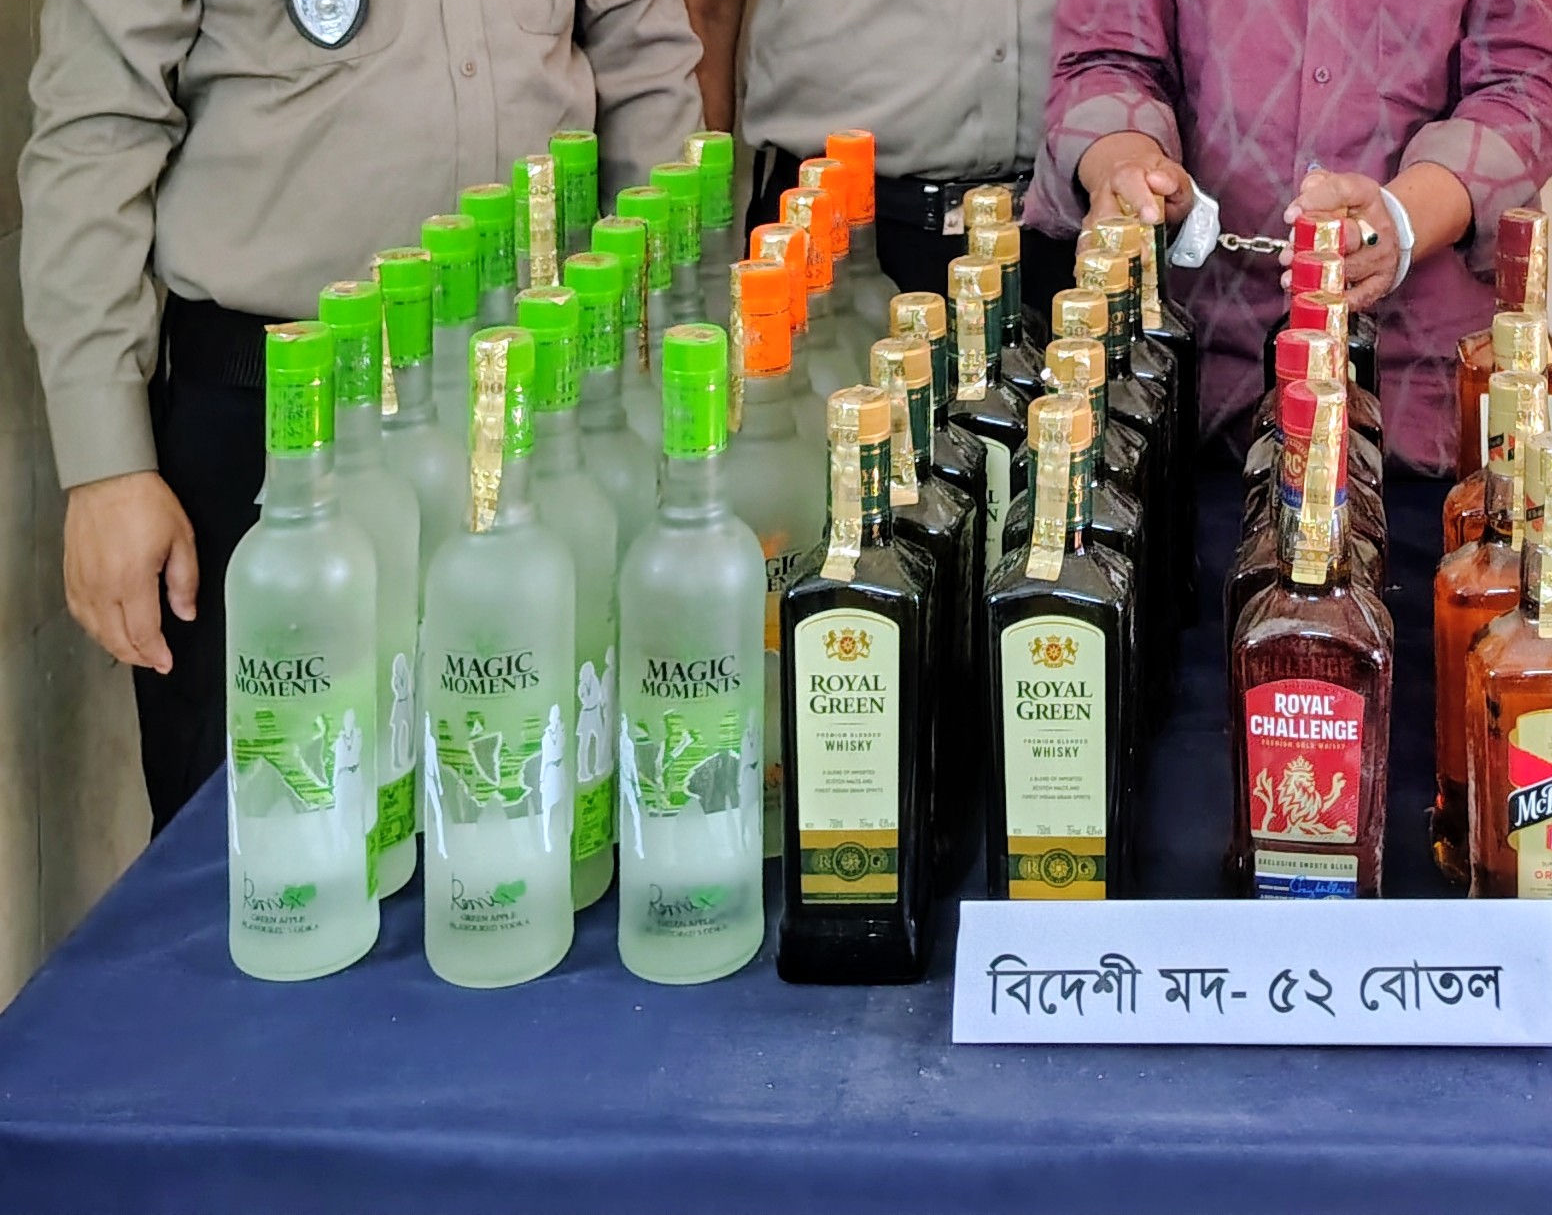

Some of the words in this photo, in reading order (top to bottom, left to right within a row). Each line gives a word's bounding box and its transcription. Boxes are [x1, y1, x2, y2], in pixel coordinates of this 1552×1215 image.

[238, 655, 325, 681] MAGIC
[445, 651, 534, 679] MAGIC
[647, 655, 737, 683] MAGIC
[234, 674, 332, 698] MOMENTS
[440, 671, 540, 696] MOMENTS
[640, 673, 741, 700] MOMENTS
[809, 674, 887, 696] ROYAL
[1016, 680, 1093, 701] ROYAL
[809, 695, 887, 715] GREEN
[1016, 700, 1092, 721] GREEN
[1274, 692, 1334, 717] ROYAL
[1250, 714, 1358, 740] CHALLENGE
[824, 739, 873, 752] WHISKY
[1032, 746, 1079, 758] WHISKY
[987, 952, 1143, 1016] বিদেশী
[1267, 967, 1336, 1017] ৫২
[1360, 960, 1504, 1012] বোতল
